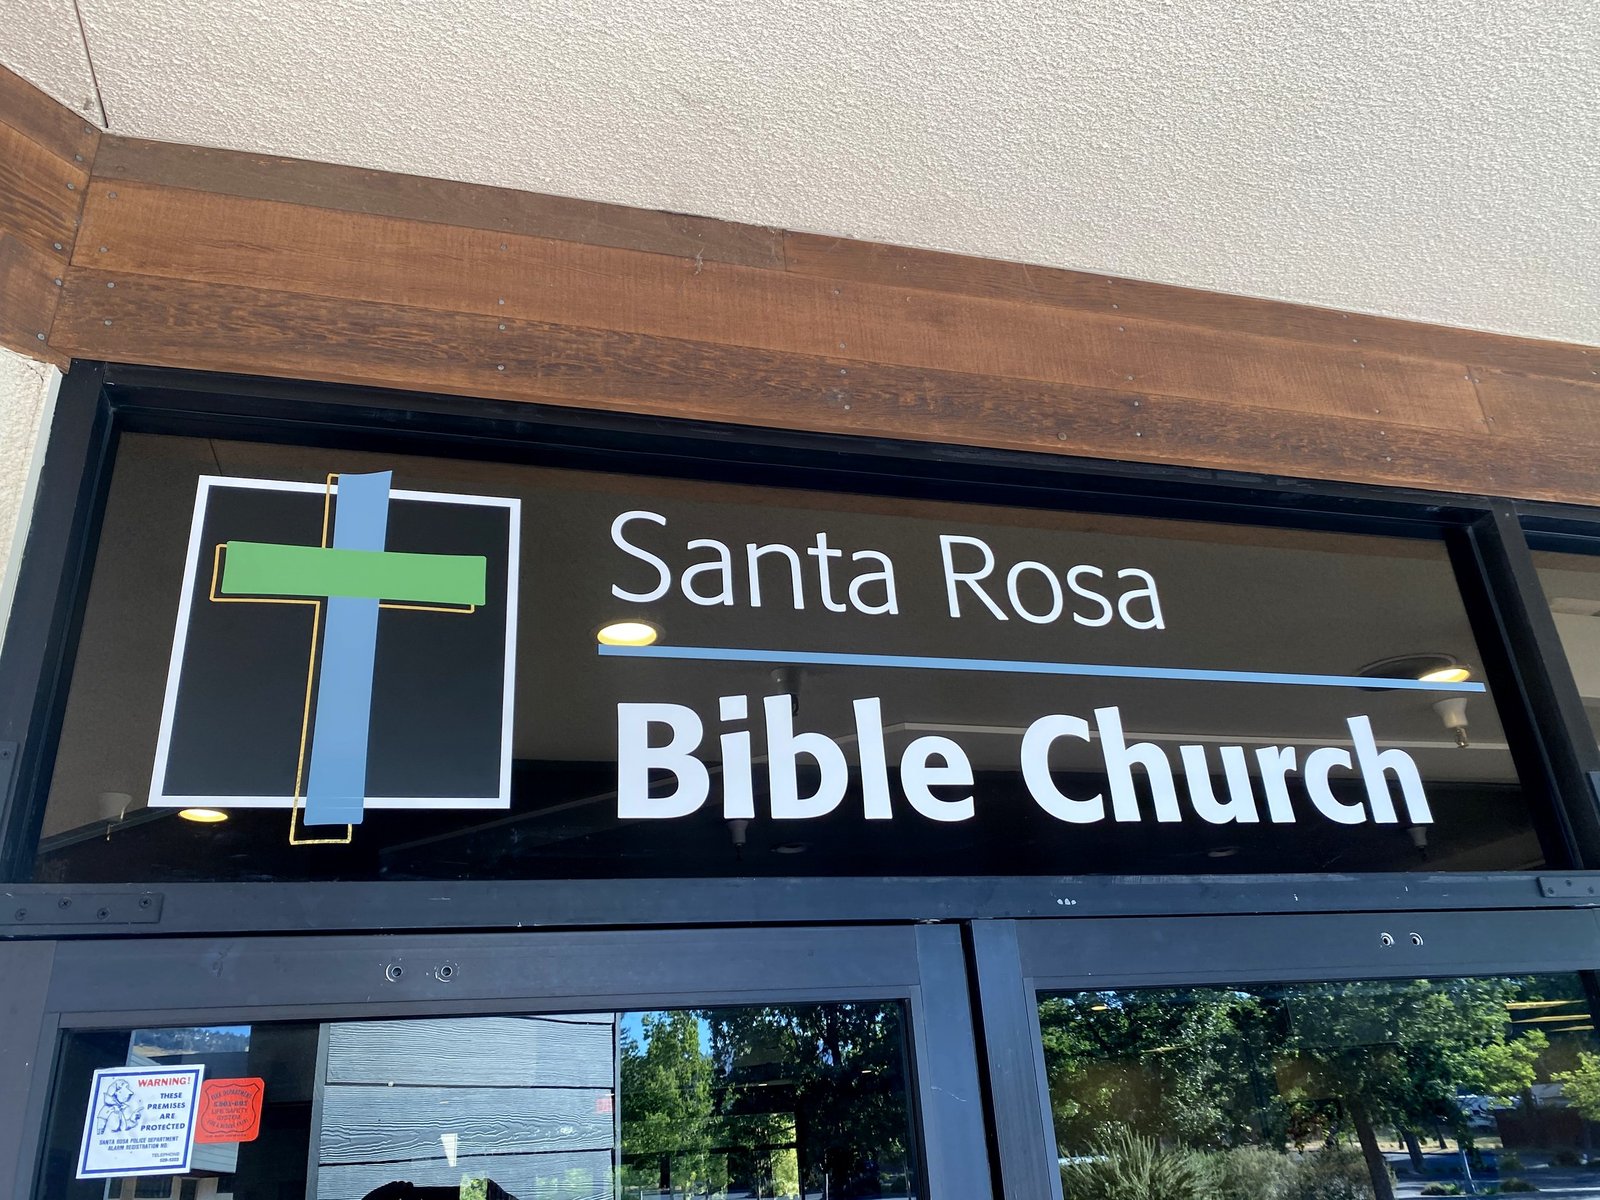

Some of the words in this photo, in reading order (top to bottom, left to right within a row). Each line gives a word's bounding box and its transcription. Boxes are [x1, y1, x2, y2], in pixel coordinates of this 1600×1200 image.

[609, 510, 899, 616] Santa
[939, 533, 1167, 631] Rosa
[616, 693, 976, 823] Bible
[1020, 705, 1435, 826] Church
[138, 1077, 191, 1087] WARNING!
[147, 1102, 186, 1110] PREMISES
[140, 1123, 186, 1131] PROTECTED
